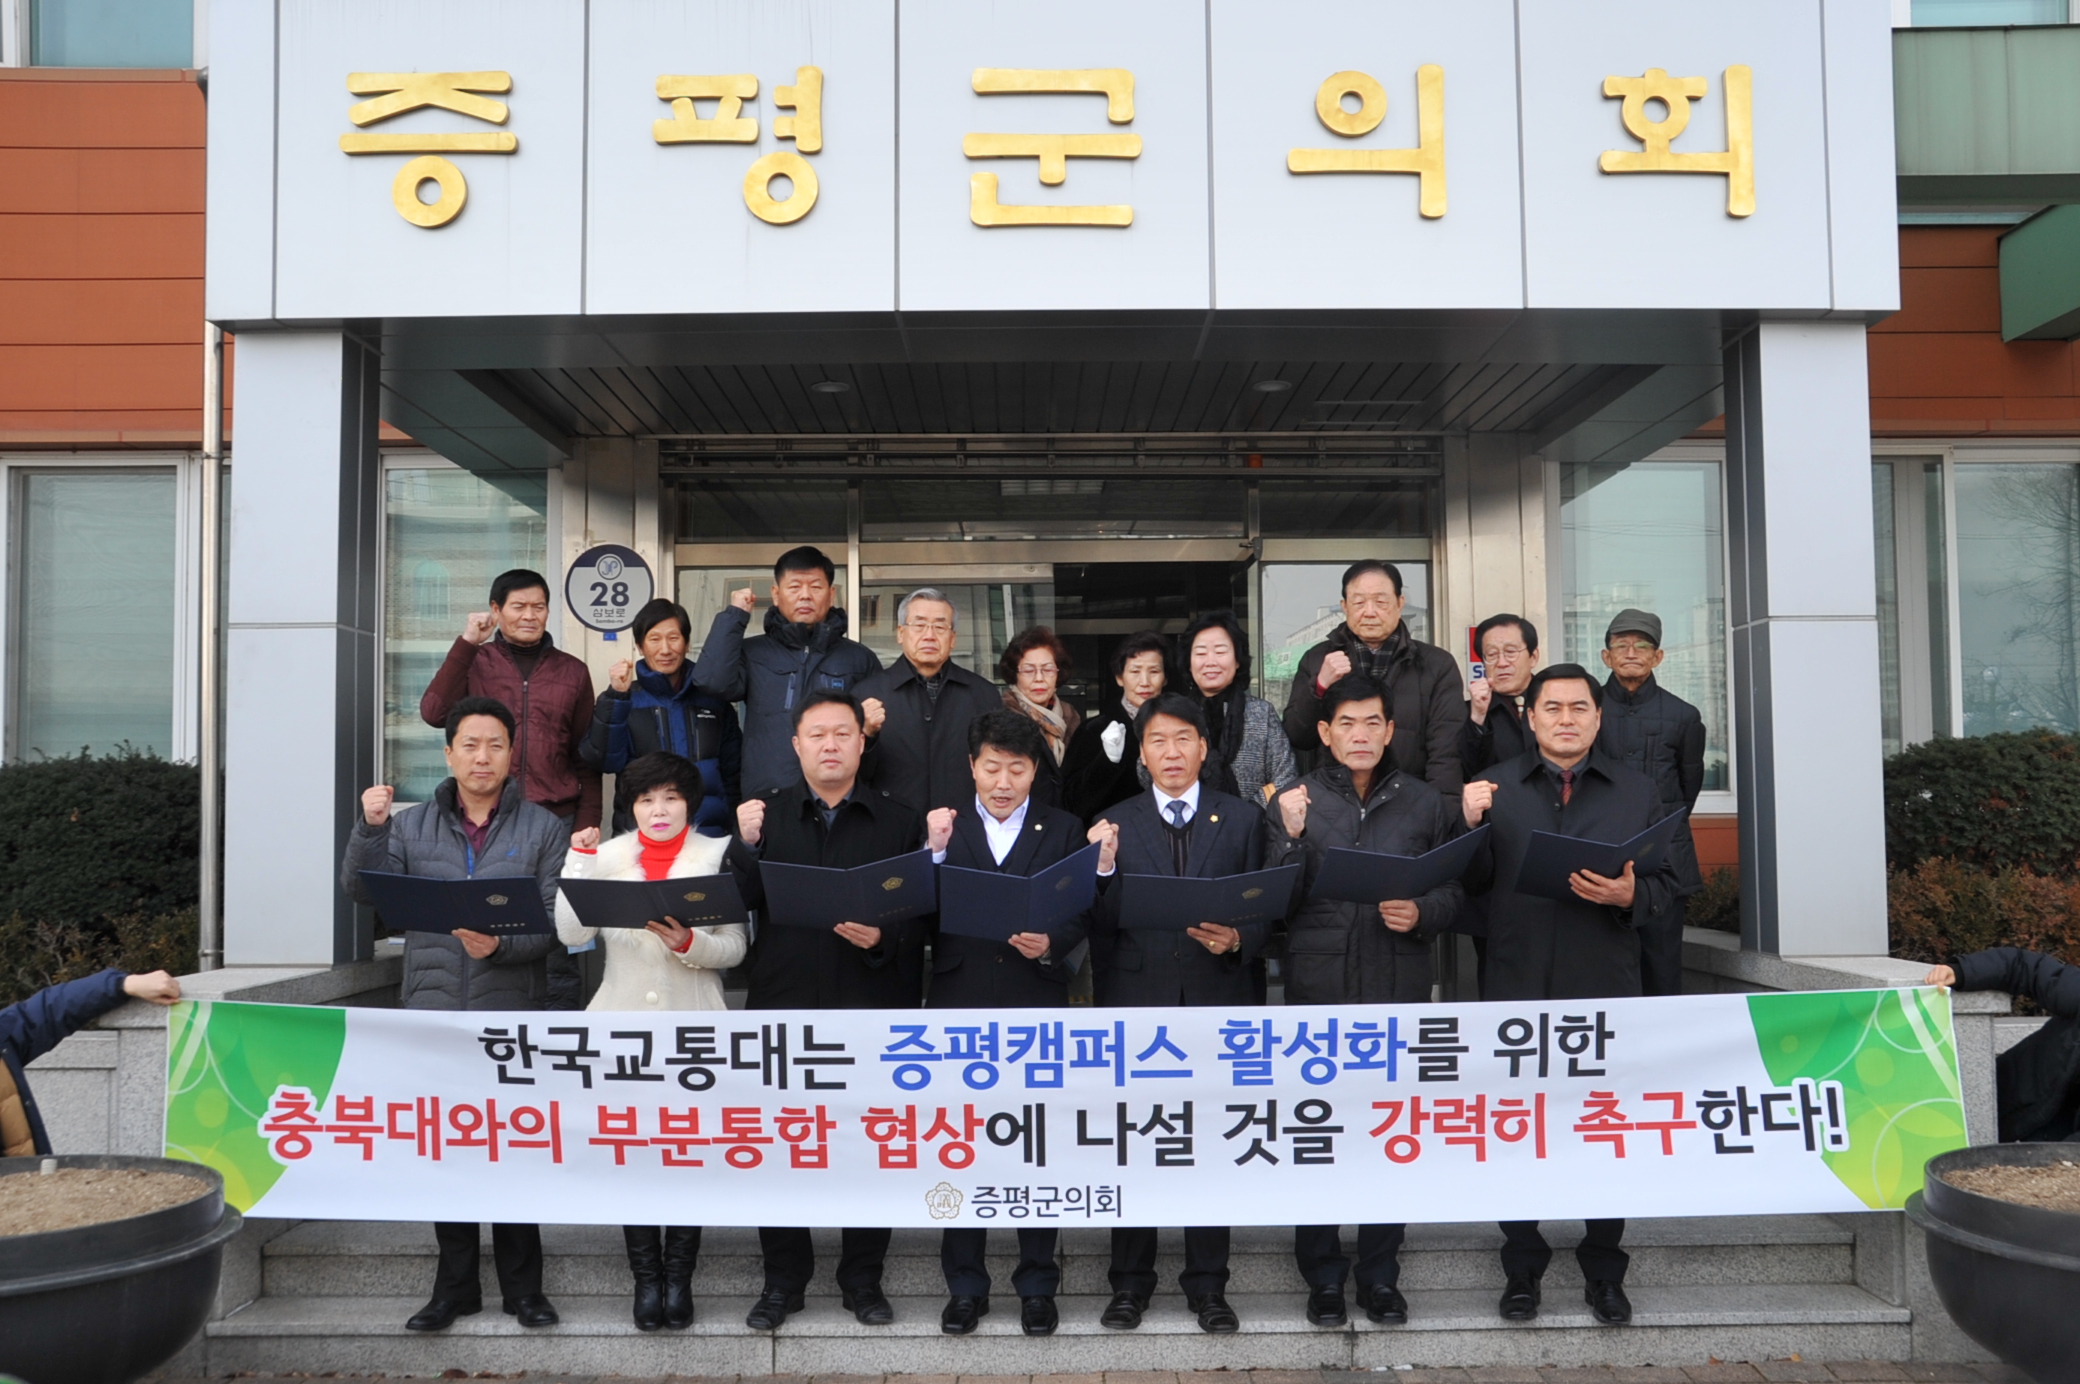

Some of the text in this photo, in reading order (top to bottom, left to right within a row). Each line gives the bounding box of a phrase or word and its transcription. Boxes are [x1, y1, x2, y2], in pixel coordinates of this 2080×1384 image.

[340, 64, 1756, 228] 증평군의회
[589, 581, 630, 607] 28
[593, 608, 626, 618] 삼보로
[476, 1010, 1616, 1092] 한국교통대는 증평캠퍼스 활성화를 위한
[263, 1084, 1844, 1170] 충북대와의 부분통합 협상에 나설 것을 강력히 촉구한다!
[971, 1184, 1122, 1219] 증평군의회
